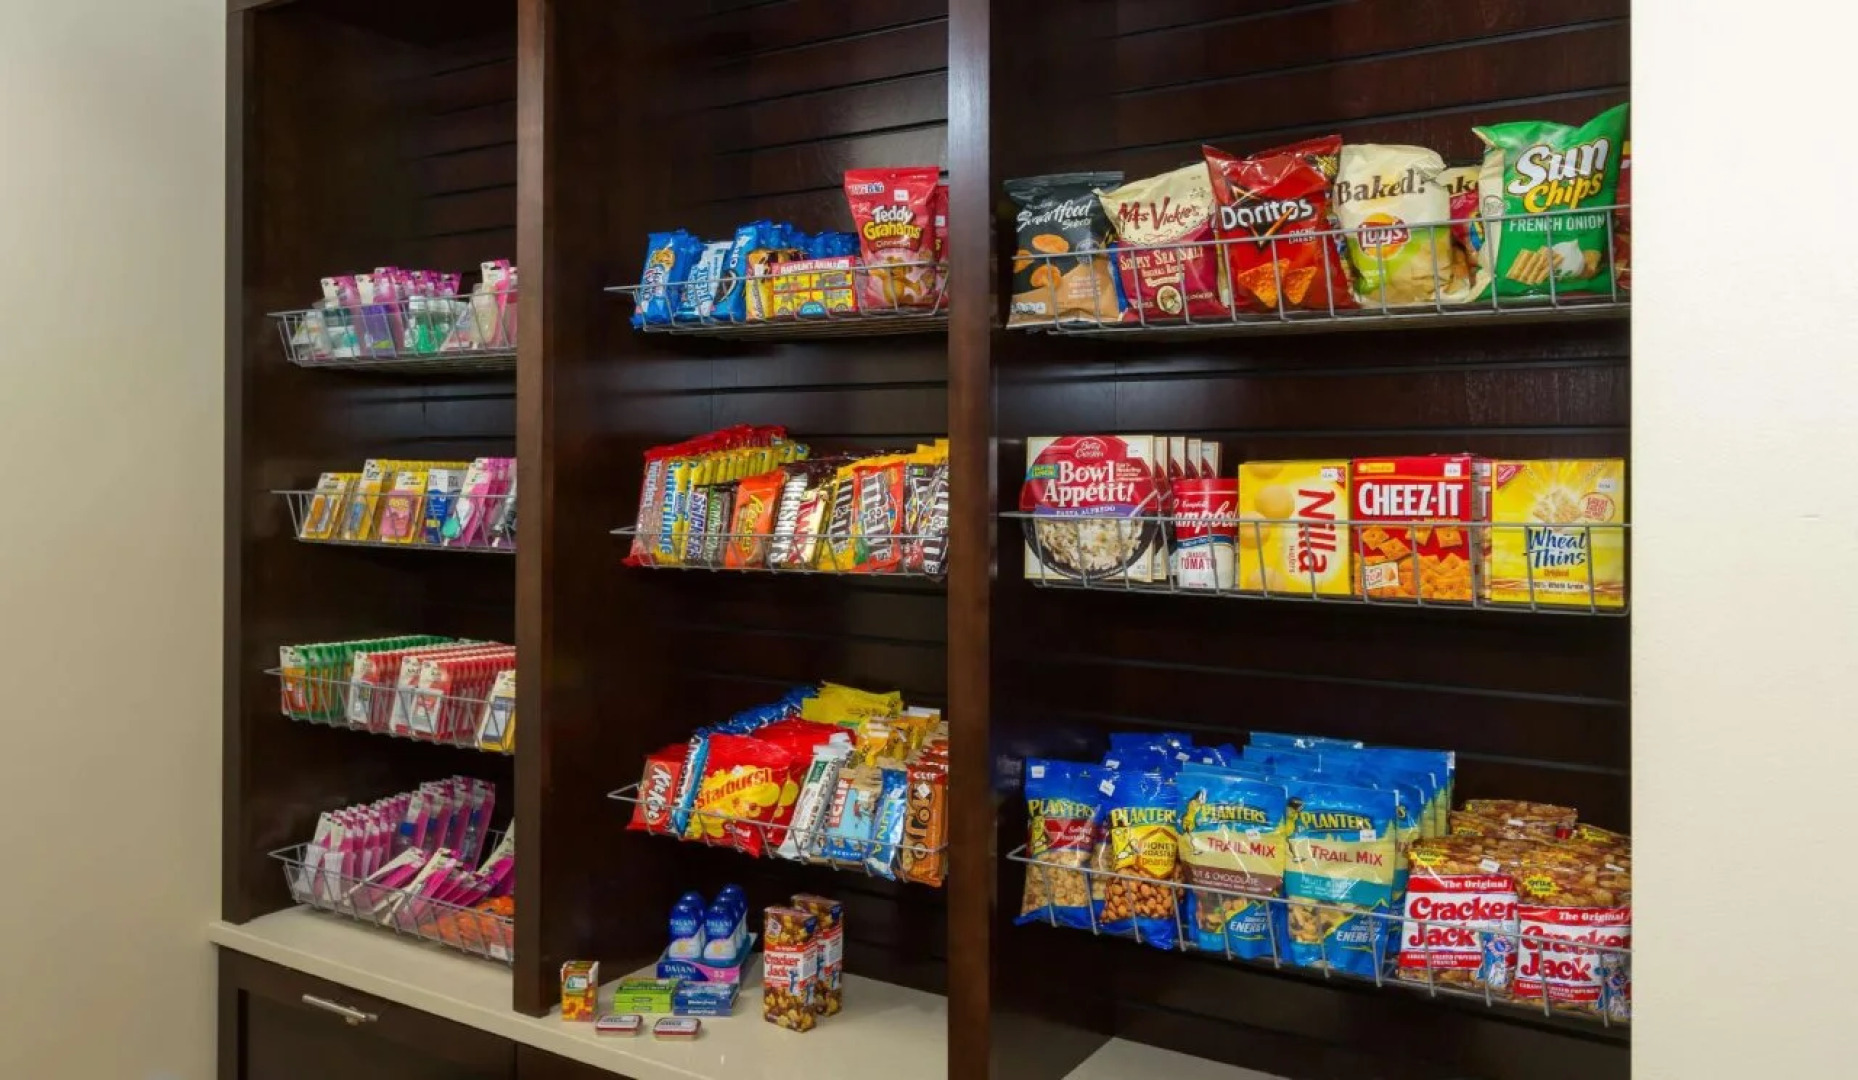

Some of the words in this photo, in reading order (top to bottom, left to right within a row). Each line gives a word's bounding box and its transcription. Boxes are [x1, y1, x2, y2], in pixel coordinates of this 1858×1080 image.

[1507, 138, 1609, 194] Sun
[1524, 173, 1604, 213] Chips
[871, 205, 914, 225] Teddy
[1016, 199, 1093, 233] Smartfood
[1220, 199, 1313, 231] Doritos
[1510, 217, 1563, 232] FRENCH
[1567, 215, 1606, 230] ONION
[863, 221, 922, 240] Grahams
[1057, 460, 1115, 484] Bowl
[1042, 479, 1135, 507] Appétit!
[1358, 481, 1464, 517] CHEEZ-IT
[1298, 489, 1336, 573] Nilla
[1522, 548, 1586, 570] Thins
[1201, 805, 1267, 823] PLANTERS
[1301, 811, 1372, 831] PLANTERS
[1207, 836, 1247, 854] TRAIL
[1249, 841, 1276, 859] MIX
[1310, 844, 1354, 863] TRAIL
[1356, 850, 1383, 867] MIX
[1443, 880, 1460, 889] The
[1464, 879, 1508, 891] Original
[1409, 896, 1518, 921] Cracker
[1581, 912, 1625, 924] Original
[1408, 921, 1477, 947] Jack
[1520, 952, 1592, 981] Jack
